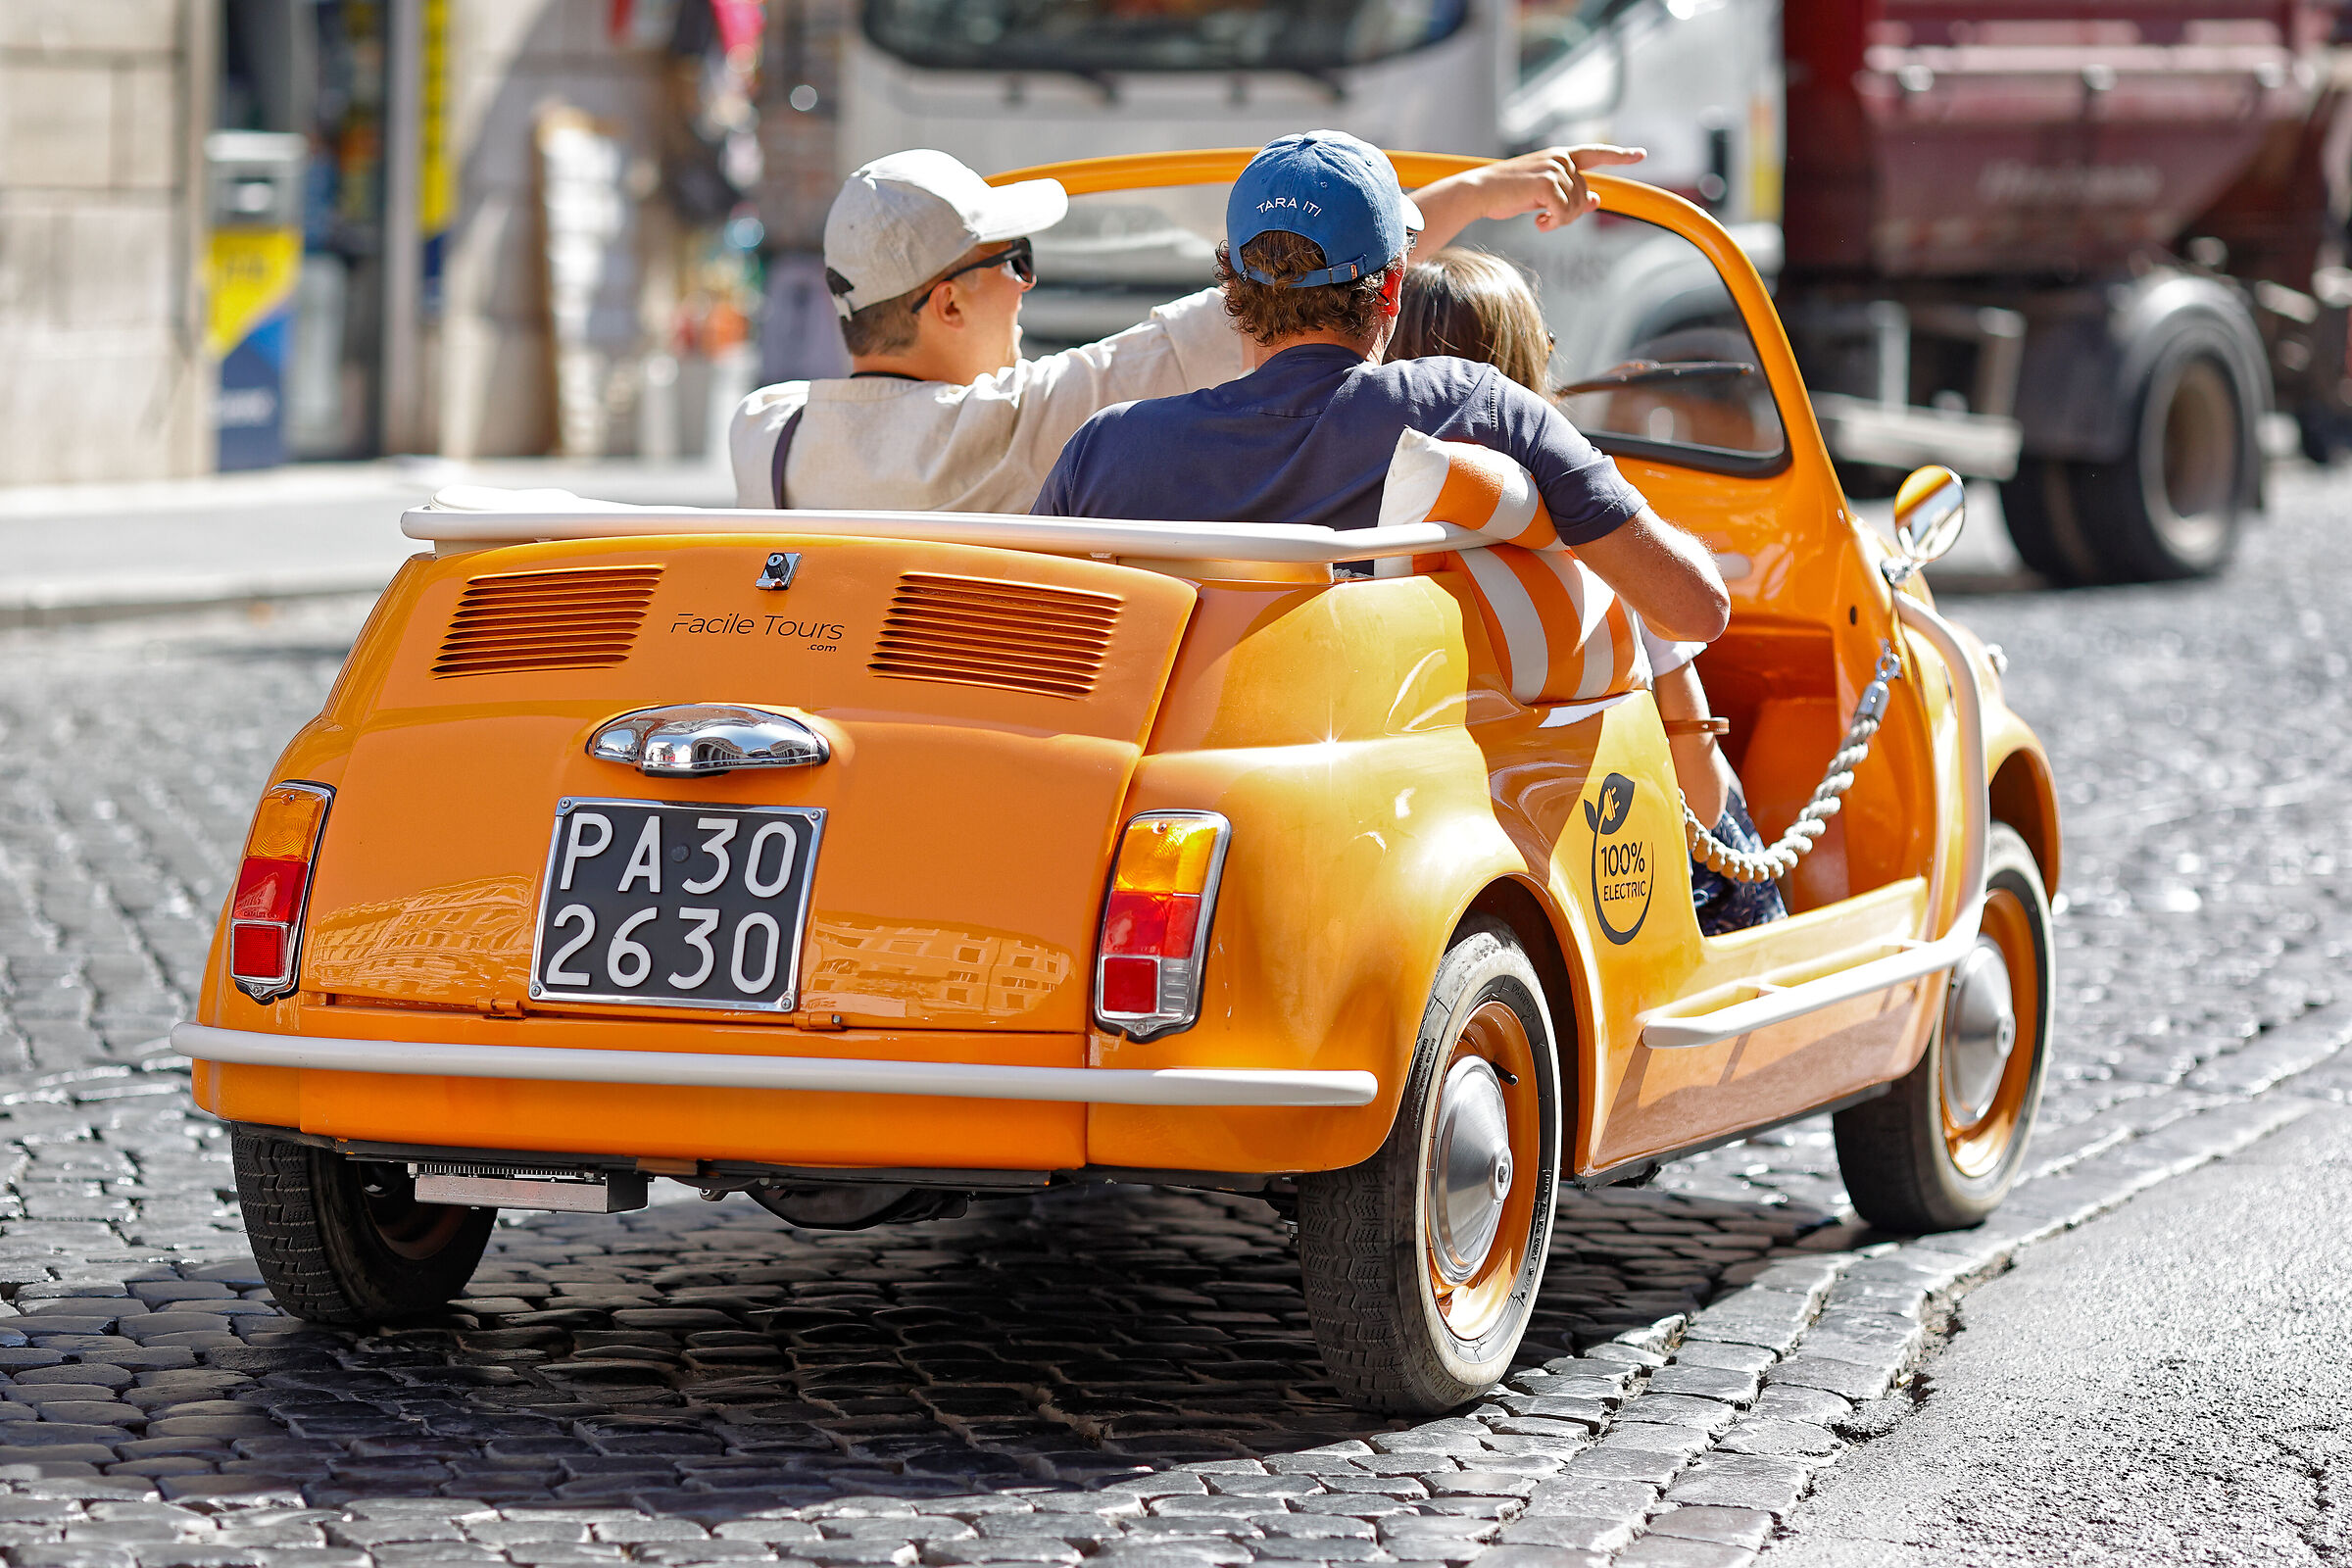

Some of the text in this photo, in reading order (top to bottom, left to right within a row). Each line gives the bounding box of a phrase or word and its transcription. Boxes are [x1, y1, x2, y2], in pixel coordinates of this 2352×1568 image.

[1255, 197, 1322, 218] TARA ITI
[670, 612, 845, 640] Facile Tours
[1600, 841, 1645, 878] 100%
[1603, 880, 1646, 902] ELECTRIC
[546, 904, 781, 995] 2630
